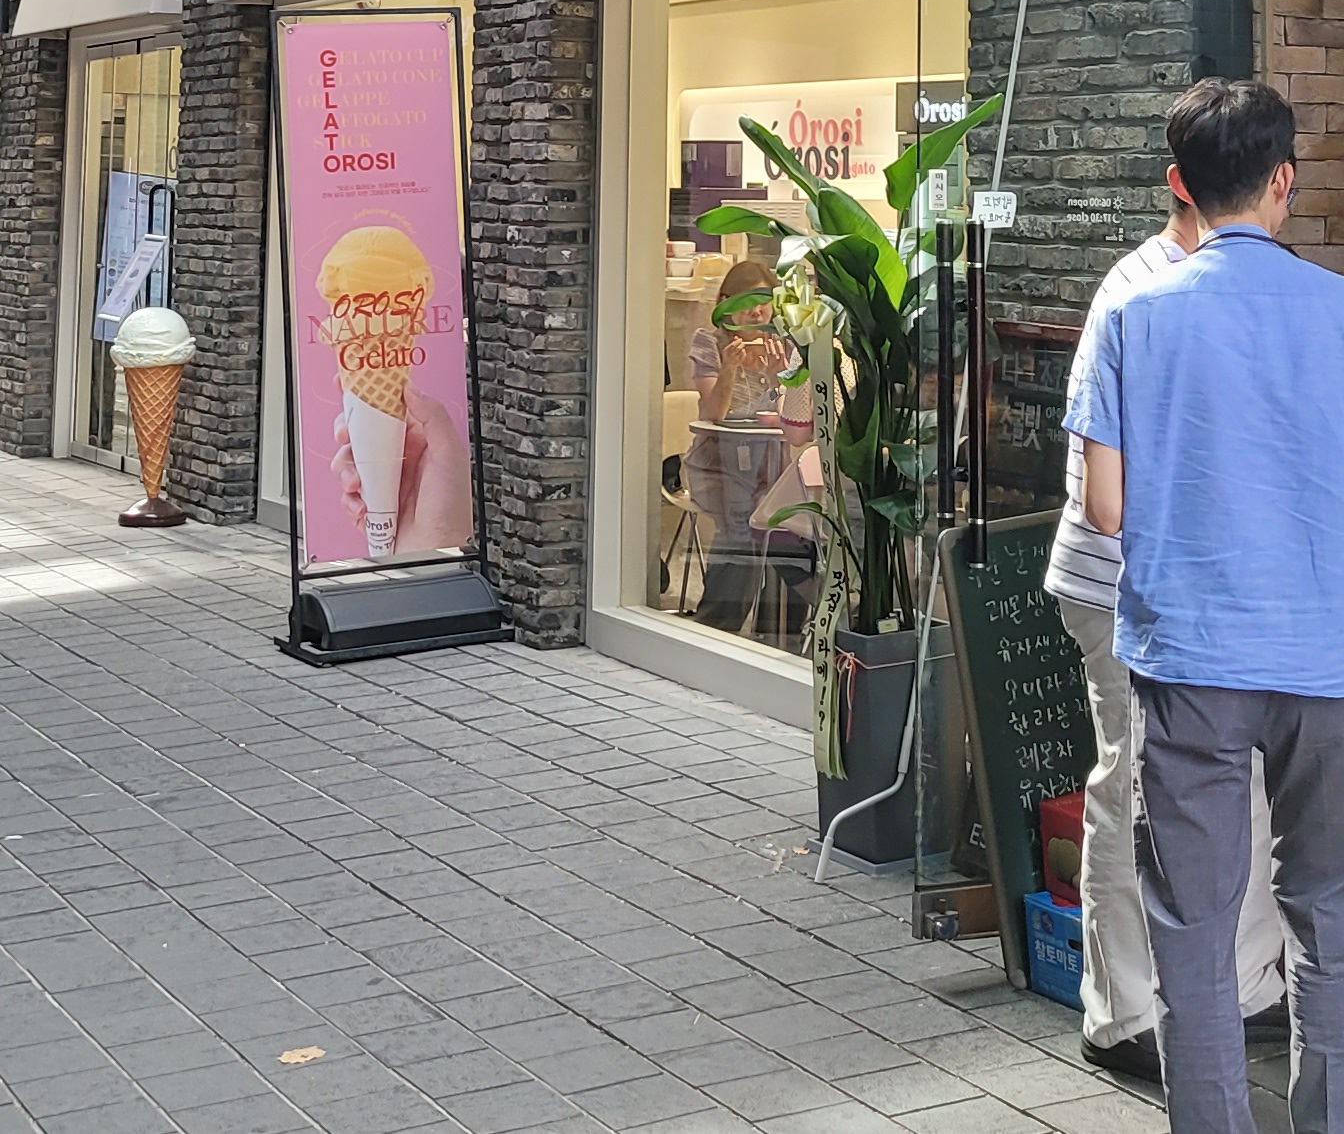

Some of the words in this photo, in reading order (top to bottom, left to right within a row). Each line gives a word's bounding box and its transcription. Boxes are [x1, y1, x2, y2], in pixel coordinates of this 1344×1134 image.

[407, 47, 444, 64] CUP
[392, 68, 443, 84] CONE
[788, 99, 863, 146] Órosi
[323, 152, 396, 173] OROSI
[935, 173, 944, 200] 미시오
[308, 304, 456, 344] NATURE
[339, 341, 426, 372] Gelato
[1035, 939, 1079, 973] 찰토마토
